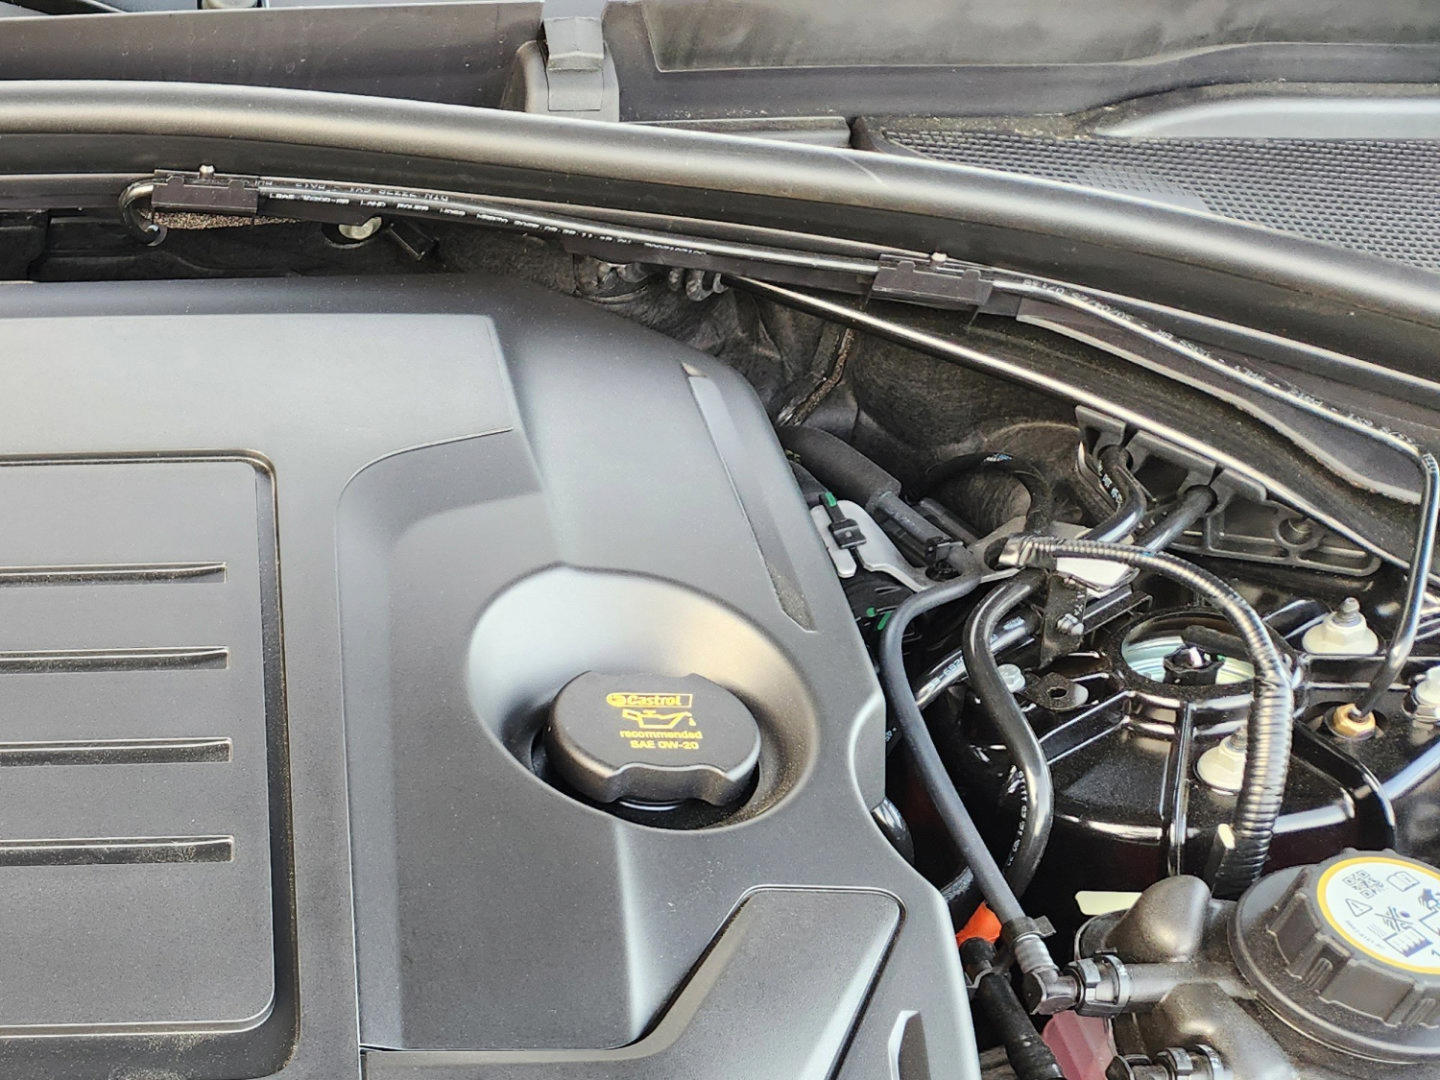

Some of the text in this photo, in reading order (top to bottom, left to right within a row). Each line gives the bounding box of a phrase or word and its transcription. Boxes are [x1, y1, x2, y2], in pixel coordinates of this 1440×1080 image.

[627, 694, 681, 706] Castrol
[620, 730, 703, 739] recommended
[630, 740, 656, 749] SAE
